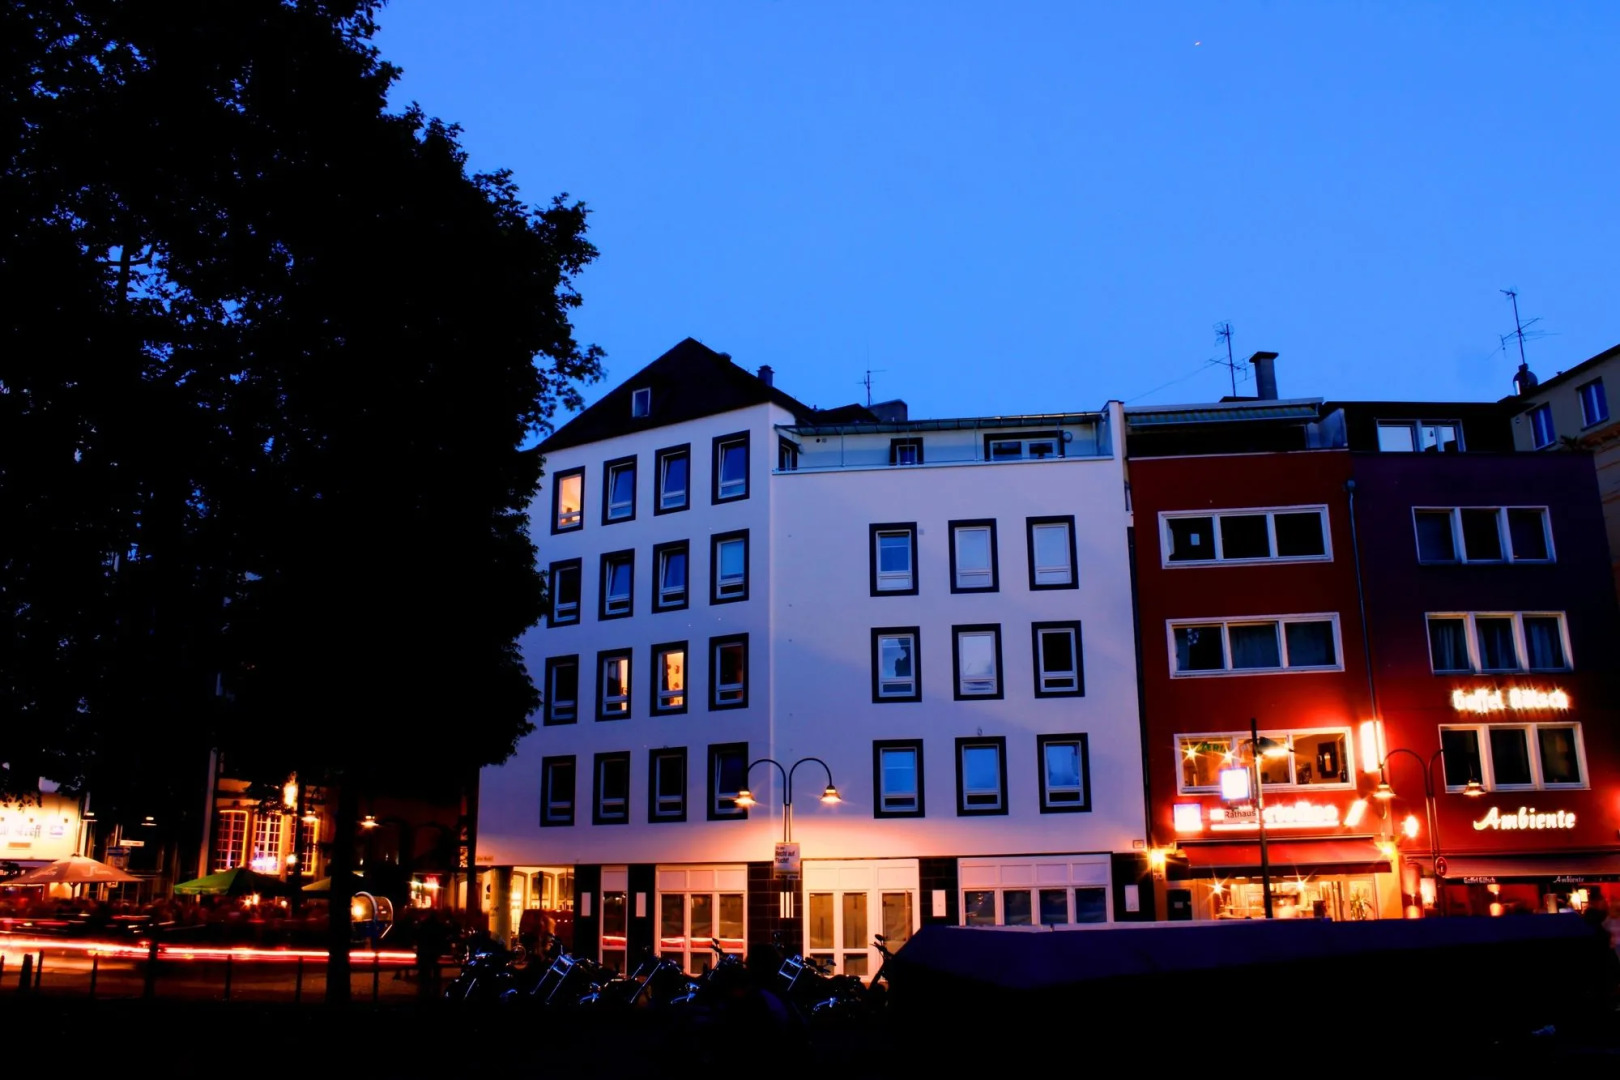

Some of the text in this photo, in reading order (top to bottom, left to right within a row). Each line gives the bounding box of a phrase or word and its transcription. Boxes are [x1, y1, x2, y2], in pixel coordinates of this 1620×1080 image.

[1224, 809, 1257, 819] Rathaus
[1473, 806, 1576, 831] Ambiente
[1553, 875, 1585, 883] Ambiente
